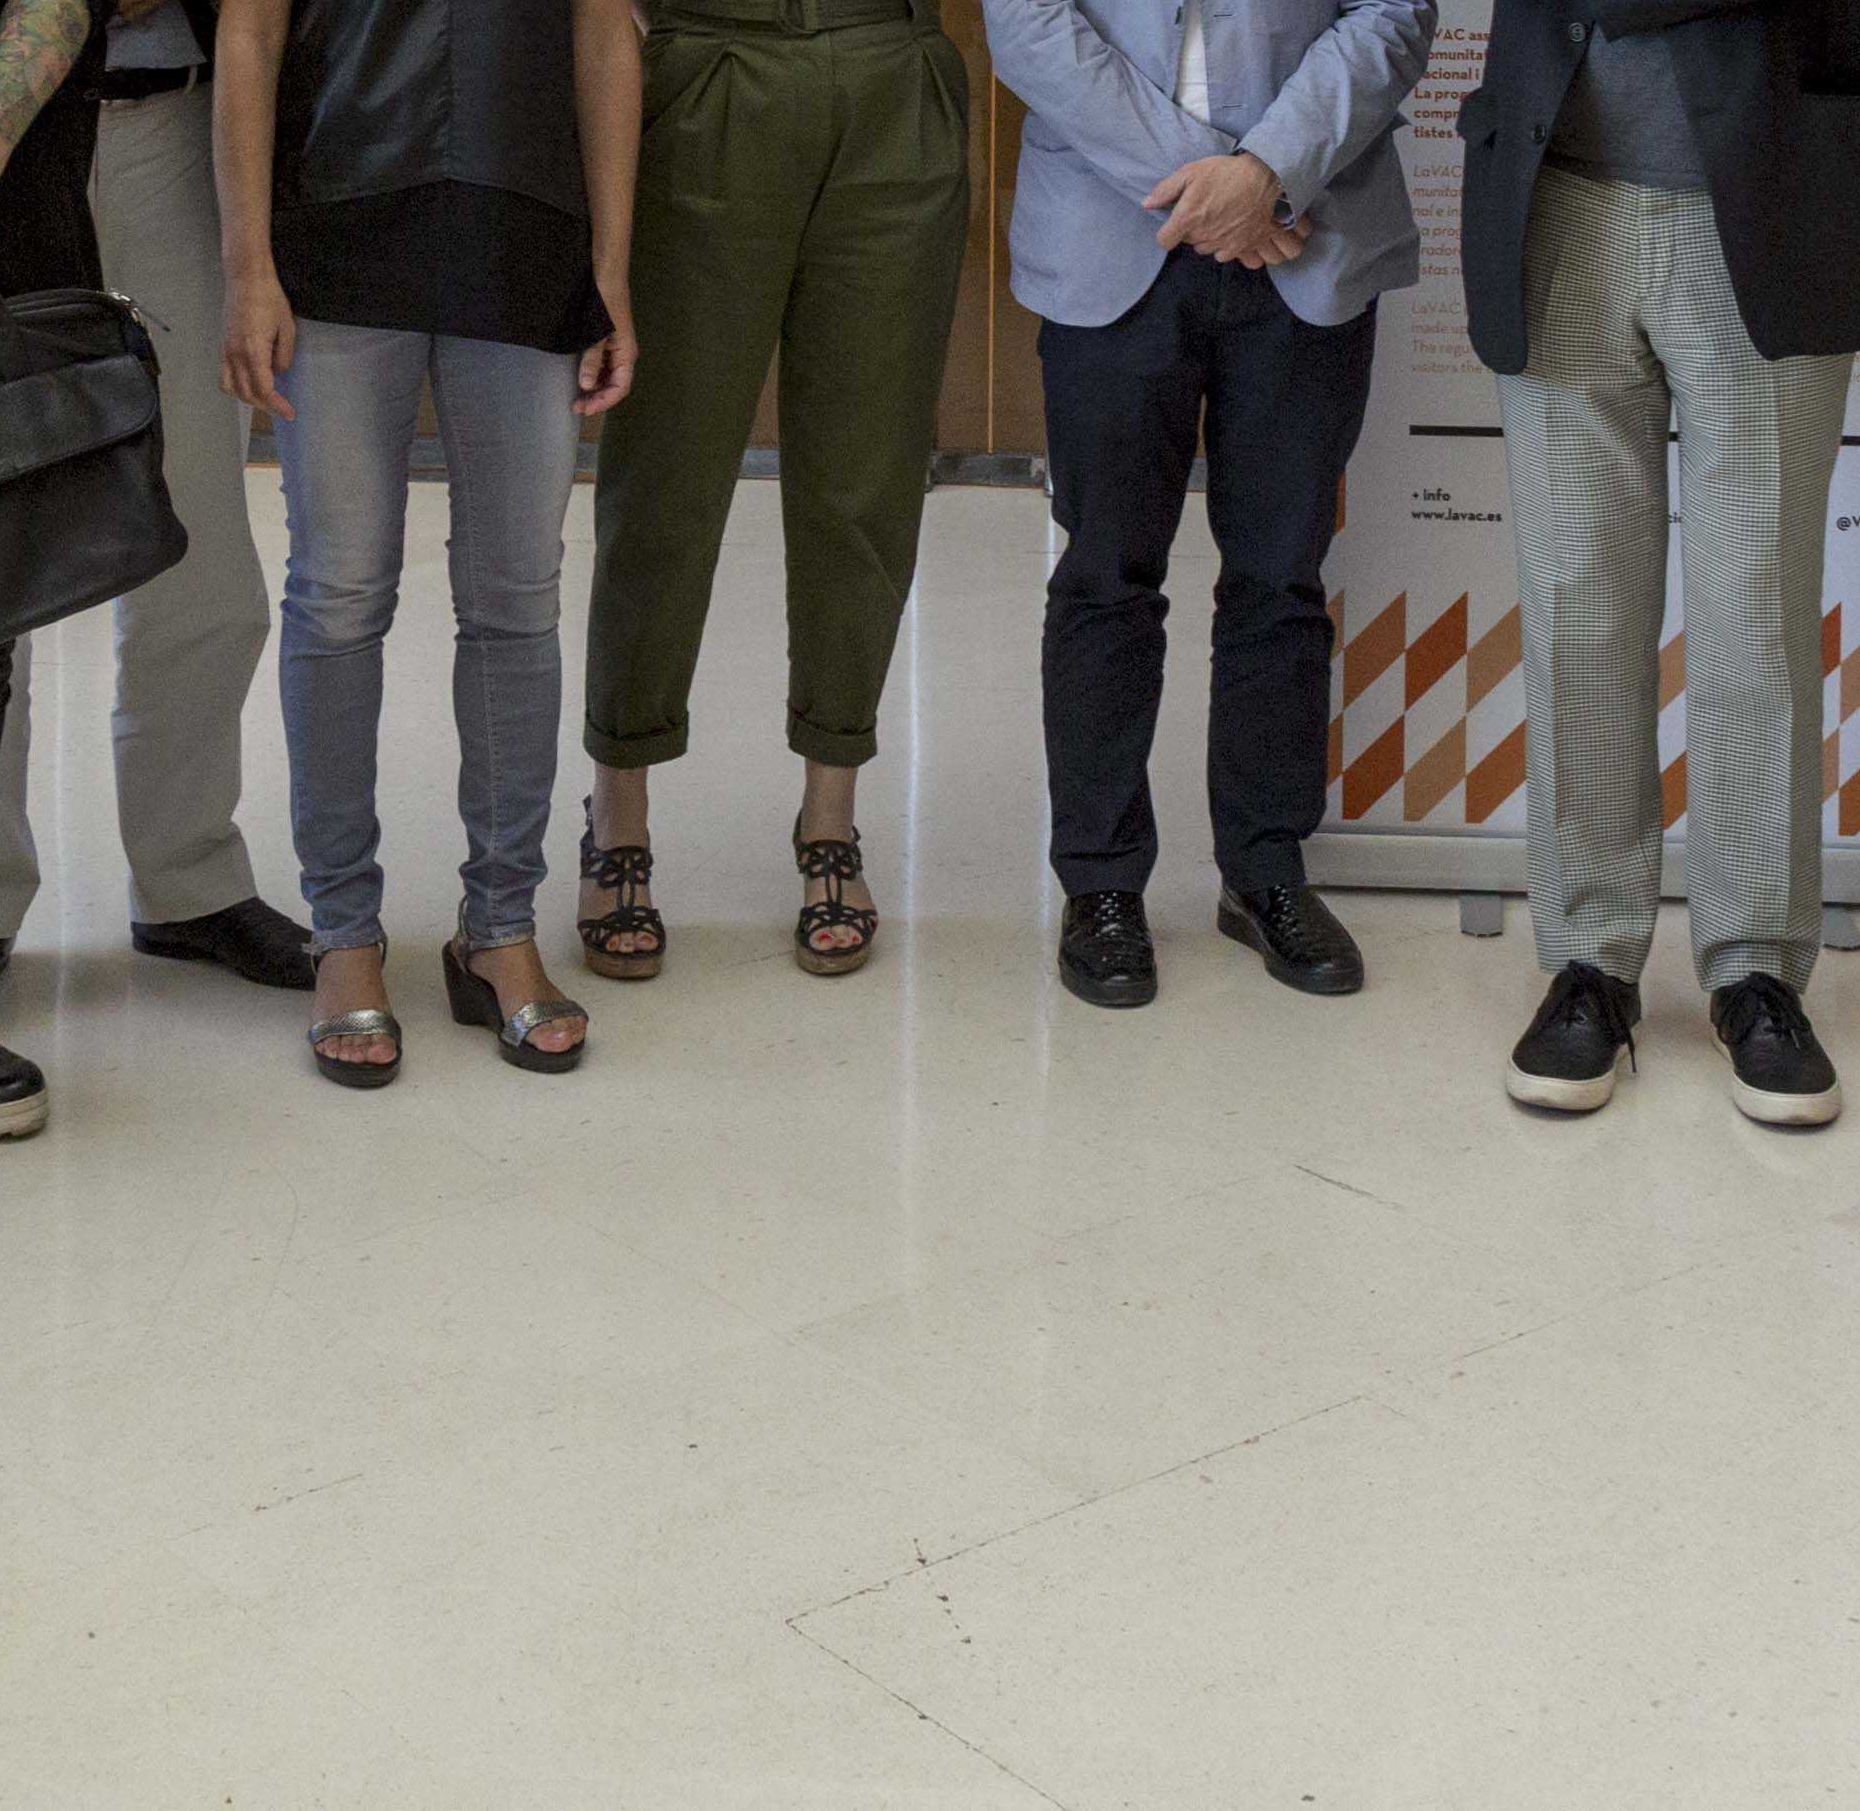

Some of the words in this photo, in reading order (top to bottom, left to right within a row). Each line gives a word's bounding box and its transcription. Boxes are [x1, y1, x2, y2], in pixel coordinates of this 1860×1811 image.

[1414, 87, 1431, 100] La
[1422, 487, 1452, 502] info
[1410, 507, 1503, 522] www.lavac.es
